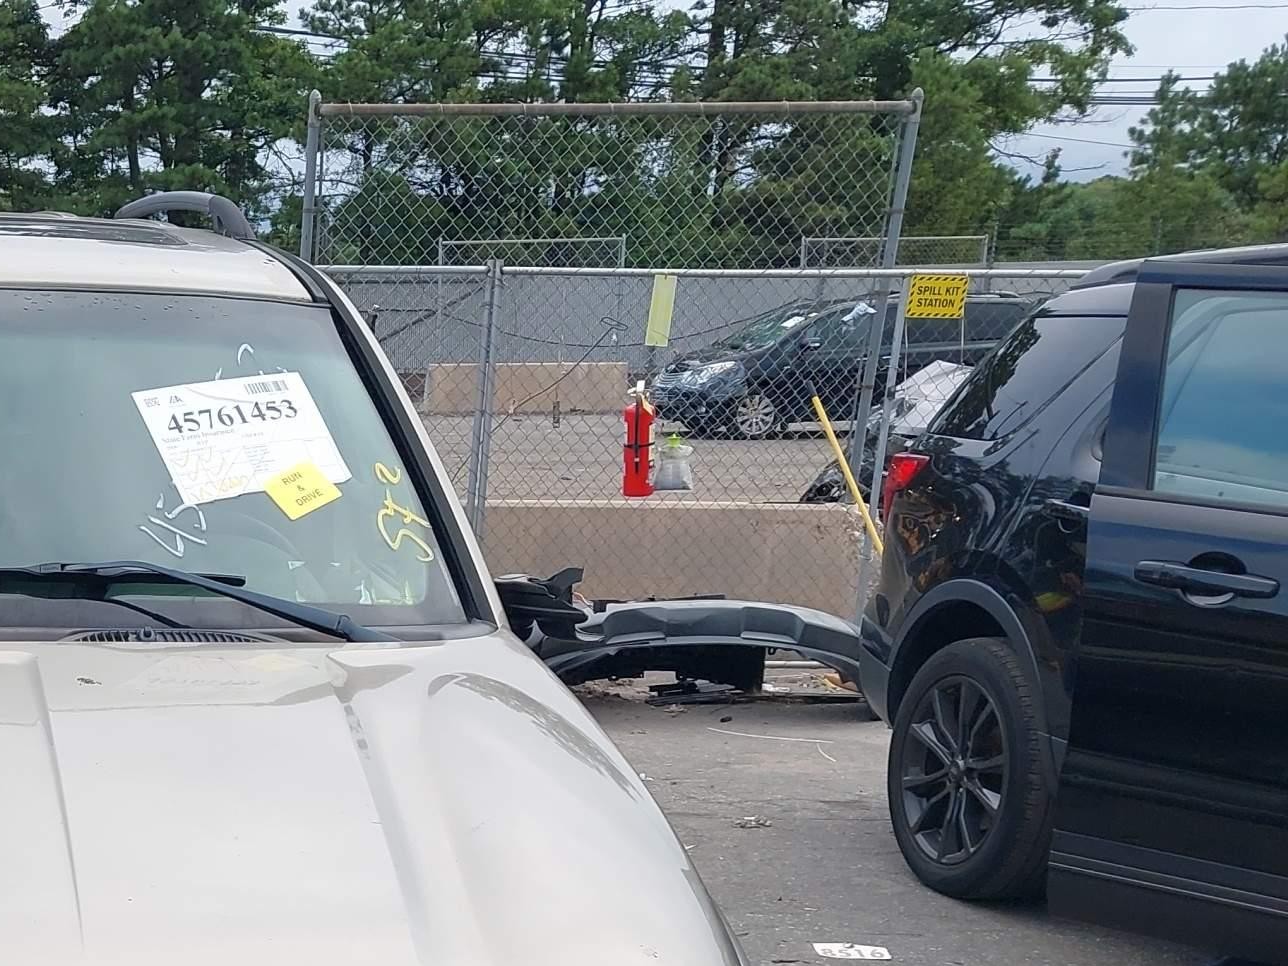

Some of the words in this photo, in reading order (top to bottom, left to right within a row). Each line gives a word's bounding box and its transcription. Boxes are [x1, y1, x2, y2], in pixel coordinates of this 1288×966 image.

[917, 286, 943, 296] SPILL
[945, 287, 961, 296] KIT
[917, 298, 955, 308] STATION
[168, 399, 298, 434] 45761453
[282, 472, 302, 486] RUN
[296, 489, 324, 506] DRIVE
